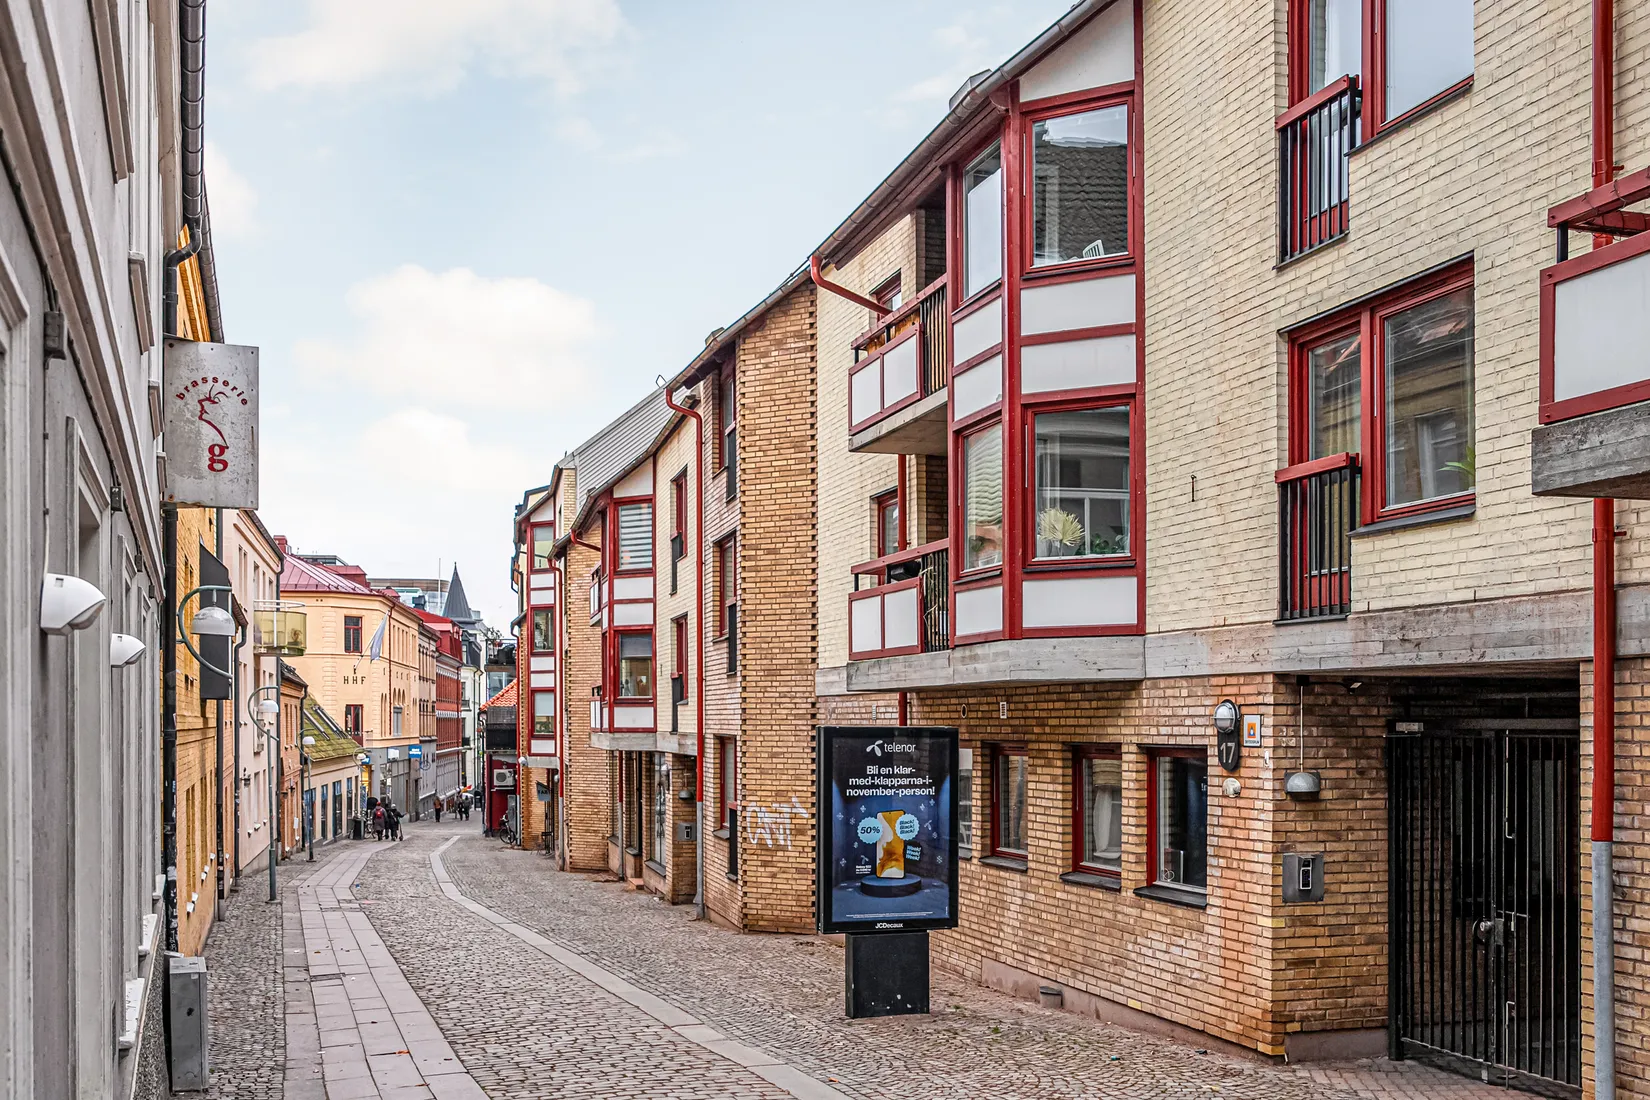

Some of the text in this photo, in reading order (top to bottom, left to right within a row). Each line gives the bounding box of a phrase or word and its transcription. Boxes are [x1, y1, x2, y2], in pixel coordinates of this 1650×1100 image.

[176, 376, 247, 406] brasserie
[884, 742, 916, 752] telenor
[1220, 742, 1236, 764] 17
[866, 765, 916, 775] Bli en klar-
[849, 776, 933, 787] med-klapparna-i-
[846, 786, 935, 797] november-person!
[860, 826, 880, 834] 50%
